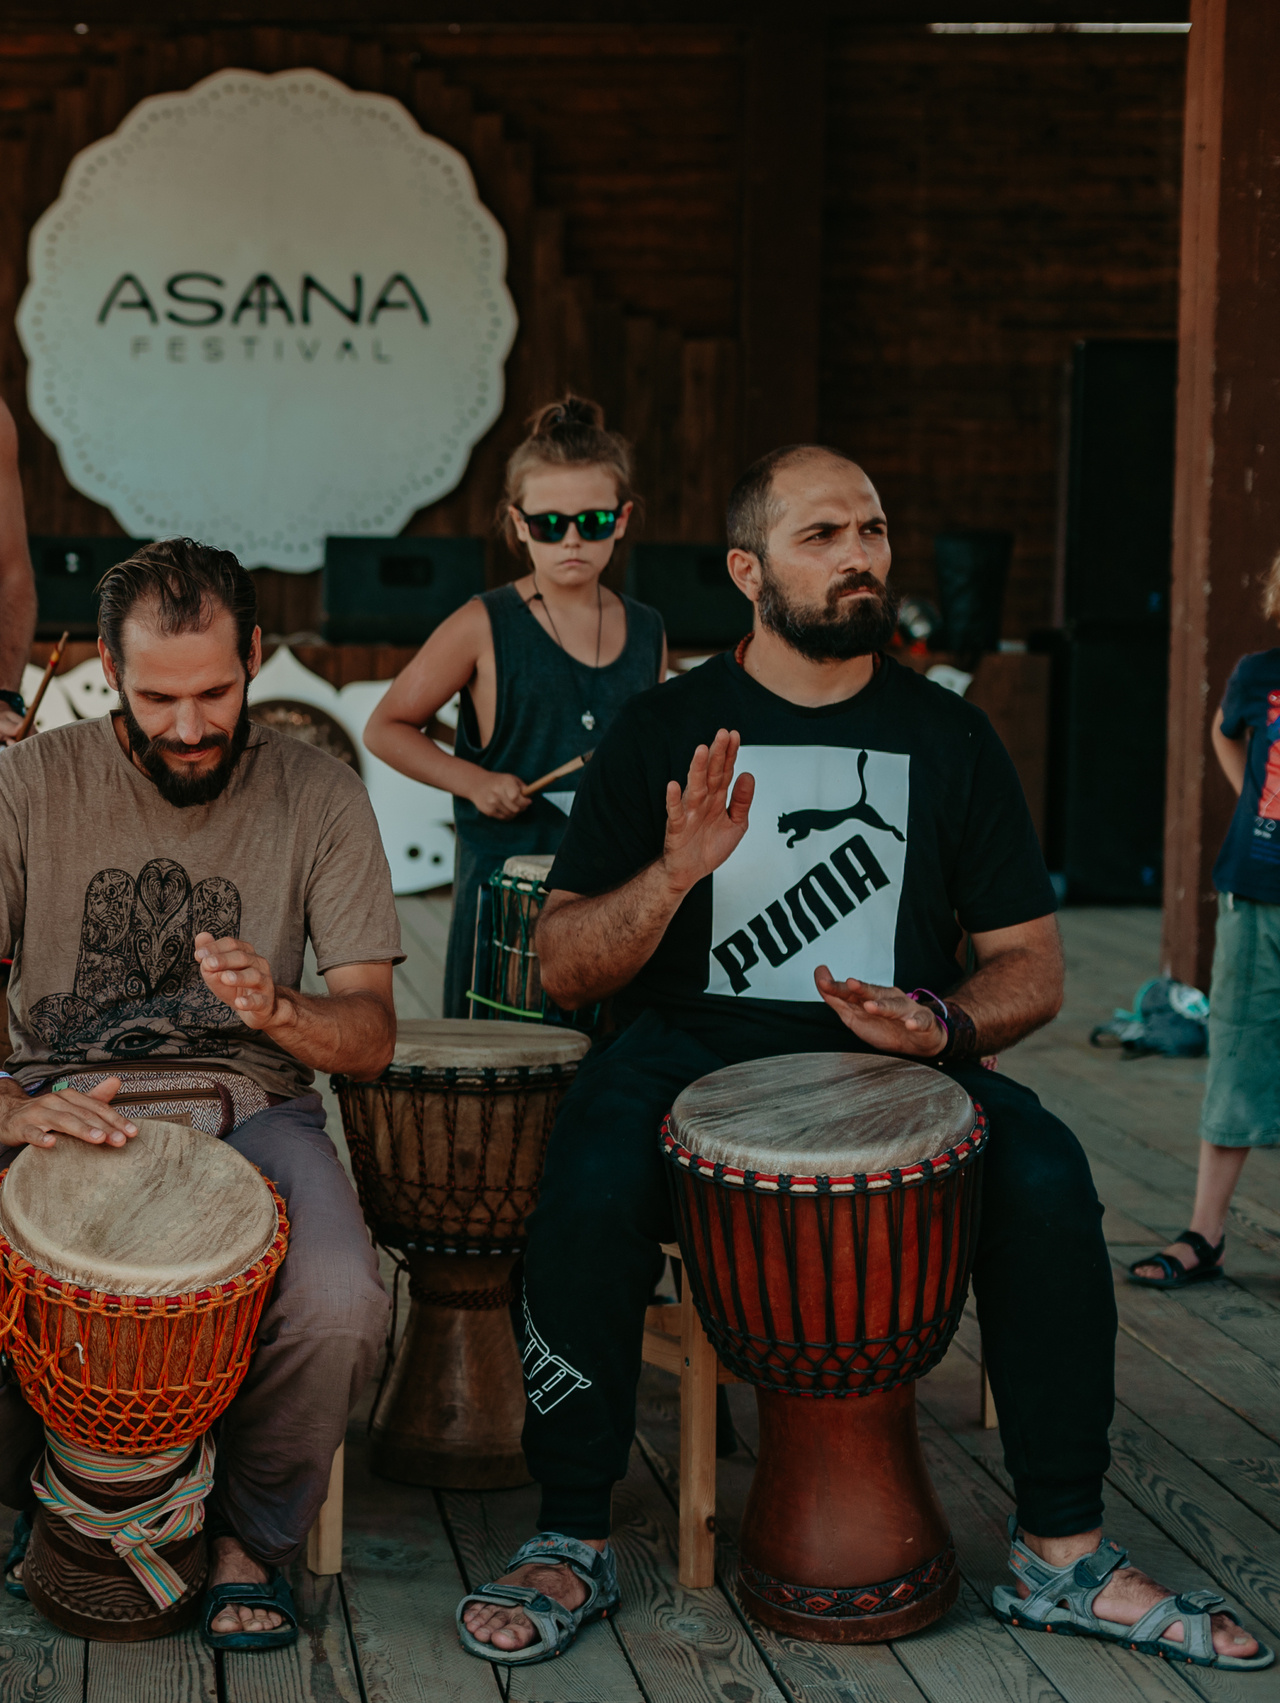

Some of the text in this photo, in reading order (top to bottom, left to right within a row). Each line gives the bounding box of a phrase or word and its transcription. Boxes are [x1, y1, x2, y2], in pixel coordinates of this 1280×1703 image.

[96, 272, 431, 328] ASANA
[131, 337, 393, 364] FESTIVAL
[711, 834, 891, 995] PUMA
